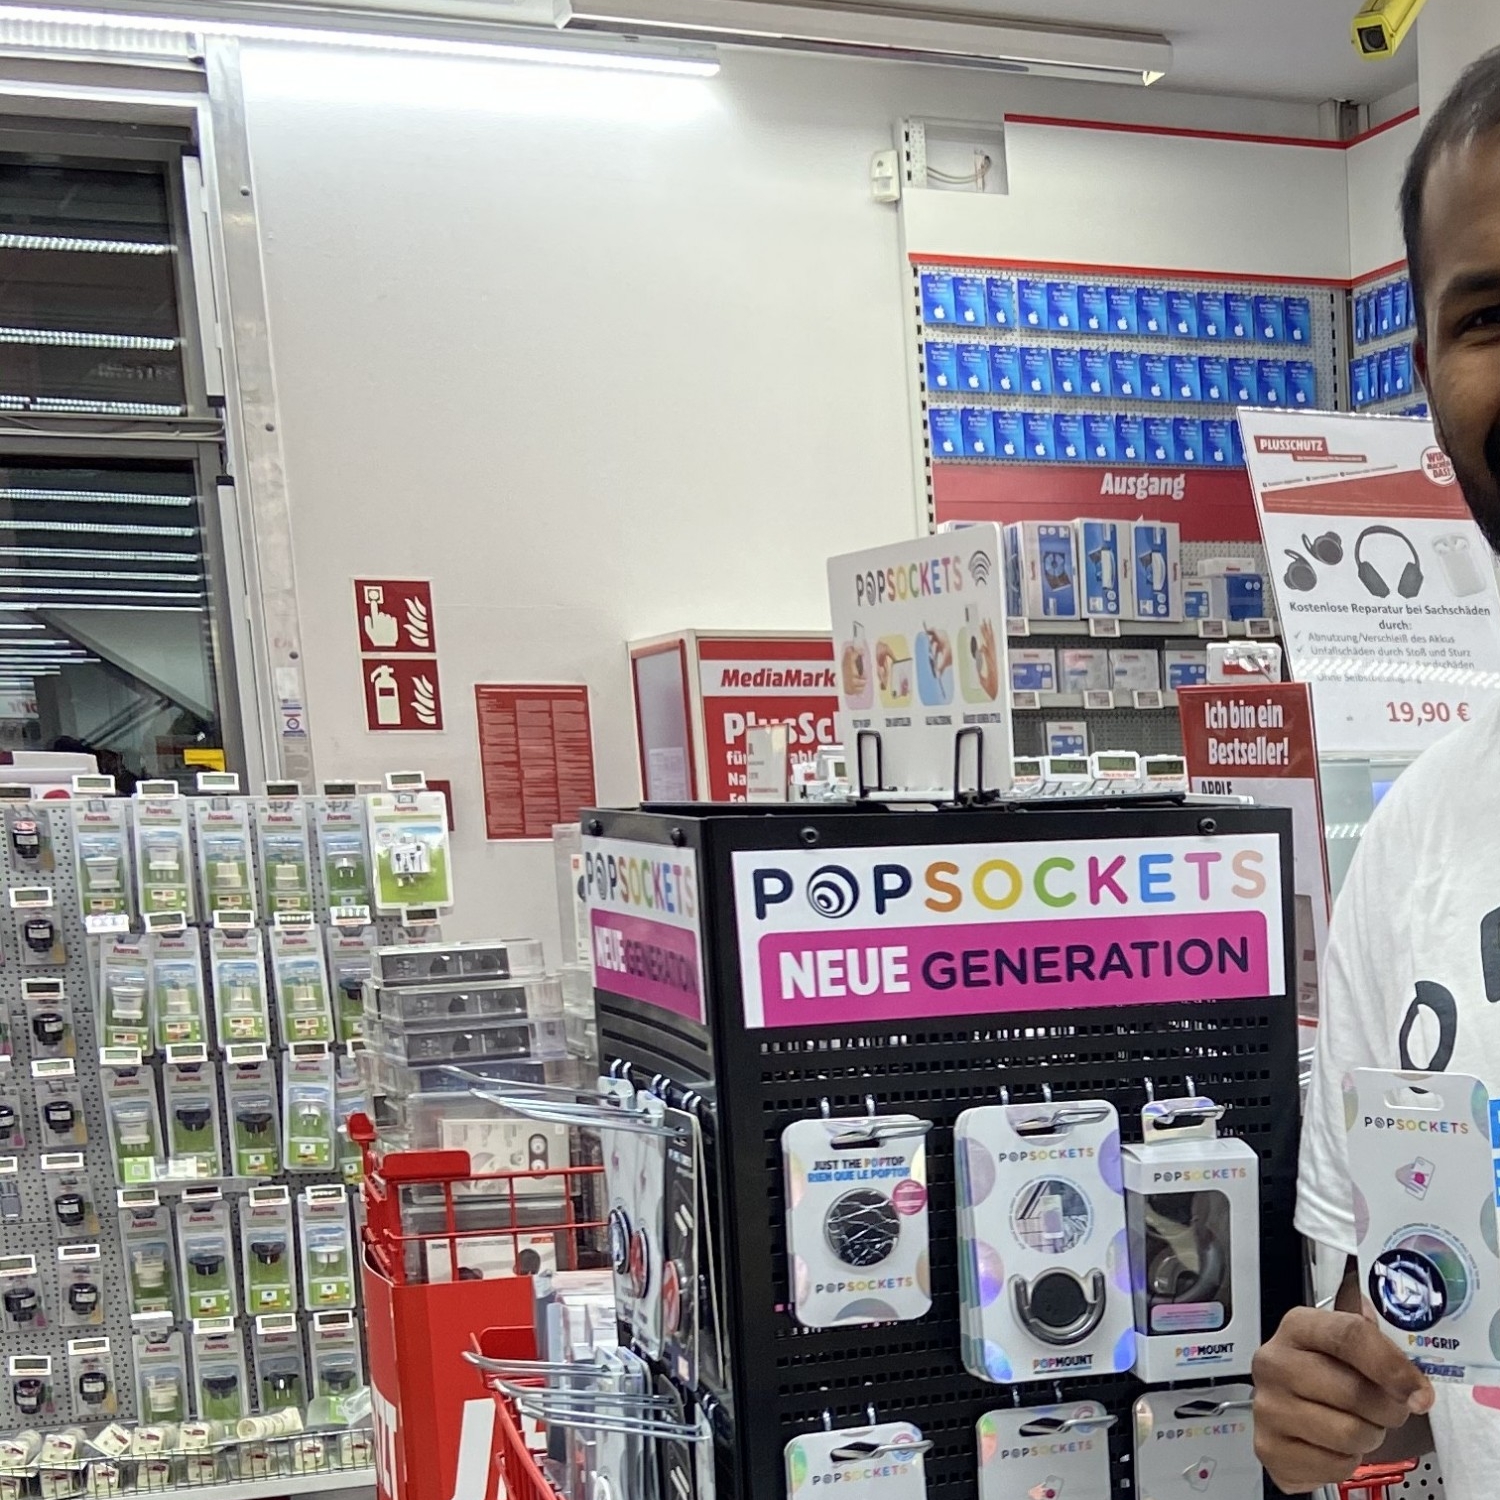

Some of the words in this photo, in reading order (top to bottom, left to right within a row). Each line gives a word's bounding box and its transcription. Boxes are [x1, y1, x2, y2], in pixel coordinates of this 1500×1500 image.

[1261, 439, 1323, 451] PLUSSCHUTZ
[1101, 472, 1185, 499] Ausgang
[856, 556, 963, 606] POPSOCKETS
[1290, 602, 1349, 613] Kostenlose
[1351, 603, 1403, 615] Reparatur
[1406, 604, 1422, 615] bei
[1425, 604, 1491, 616] Sachschäden
[1379, 619, 1413, 631] durch:
[1411, 634, 1426, 644] des
[1378, 647, 1402, 657] durch
[1430, 647, 1446, 657] und
[721, 669, 836, 687] MediaMark
[1204, 701, 1227, 729] Ich
[1230, 700, 1254, 729] bin
[1258, 699, 1283, 728] ein
[1387, 702, 1450, 725] 19,90
[1457, 703, 1471, 722] €
[1208, 737, 1288, 765] Bestseller!
[586, 852, 694, 918] POPSOCKETS
[753, 850, 1267, 921] POPSOCKETS
[780, 946, 910, 1001] NEUE
[921, 936, 1249, 991] GENERATION
[1364, 1116, 1469, 1135] POPSOCKETS
[999, 1147, 1094, 1162] POPSOCKETS
[815, 1159, 839, 1171] JUST
[842, 1158, 862, 1169] THE
[864, 1156, 905, 1168] POPTOP
[1154, 1167, 1246, 1182] POPSOCKETS
[815, 1277, 913, 1293] POPSOCKETS
[1175, 1342, 1235, 1357] POPMOUNT
[1408, 1335, 1460, 1350] POPGRIP
[1033, 1354, 1094, 1369] POPMOUNT
[1157, 1424, 1245, 1440] POPSOCKETS
[1002, 1440, 1092, 1459] POPSOCKETS
[813, 1466, 908, 1485] POPSOCKETS
